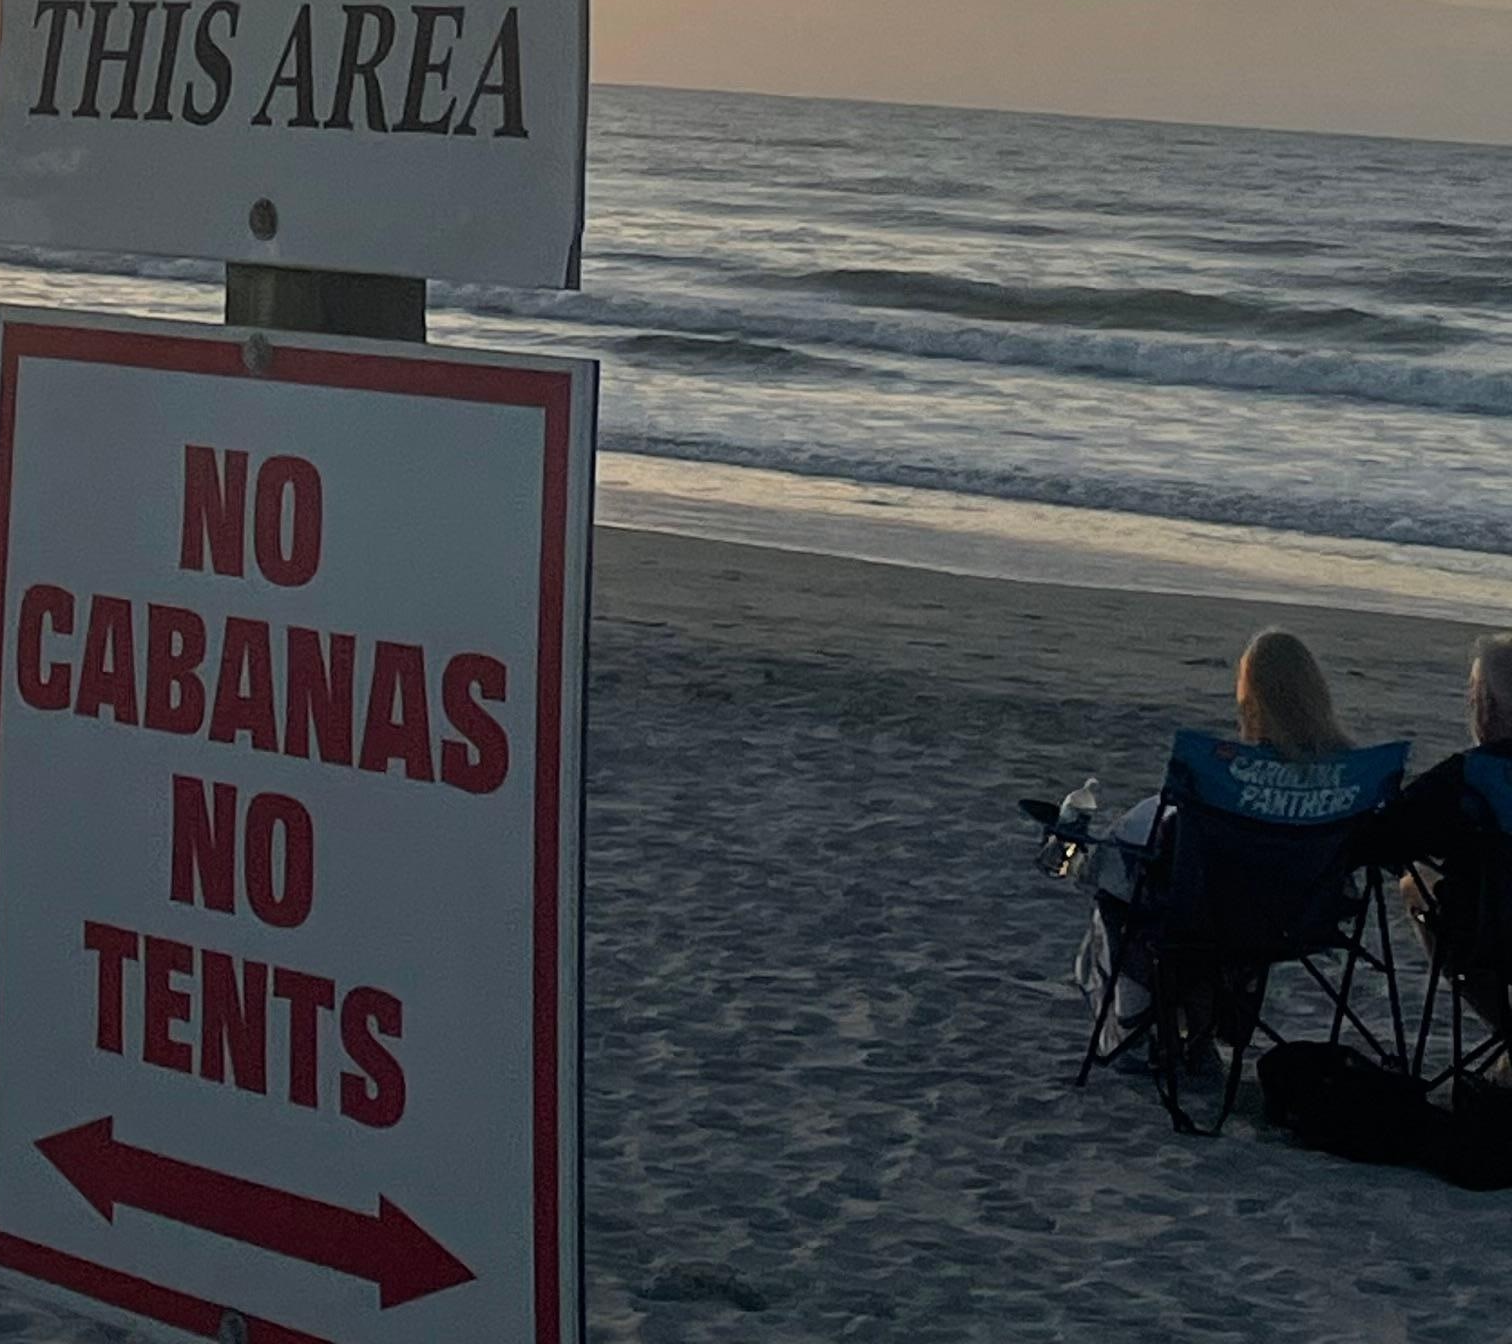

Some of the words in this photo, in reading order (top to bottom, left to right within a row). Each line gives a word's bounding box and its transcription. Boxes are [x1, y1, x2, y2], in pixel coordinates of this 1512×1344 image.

[29, 0, 240, 126] THIS
[251, 4, 529, 140] AREA
[179, 444, 323, 587] NO
[17, 584, 510, 794] CABANAS
[170, 773, 314, 928] NO
[1237, 784, 1361, 818] PANTHERS
[84, 920, 406, 1129] TENTS
